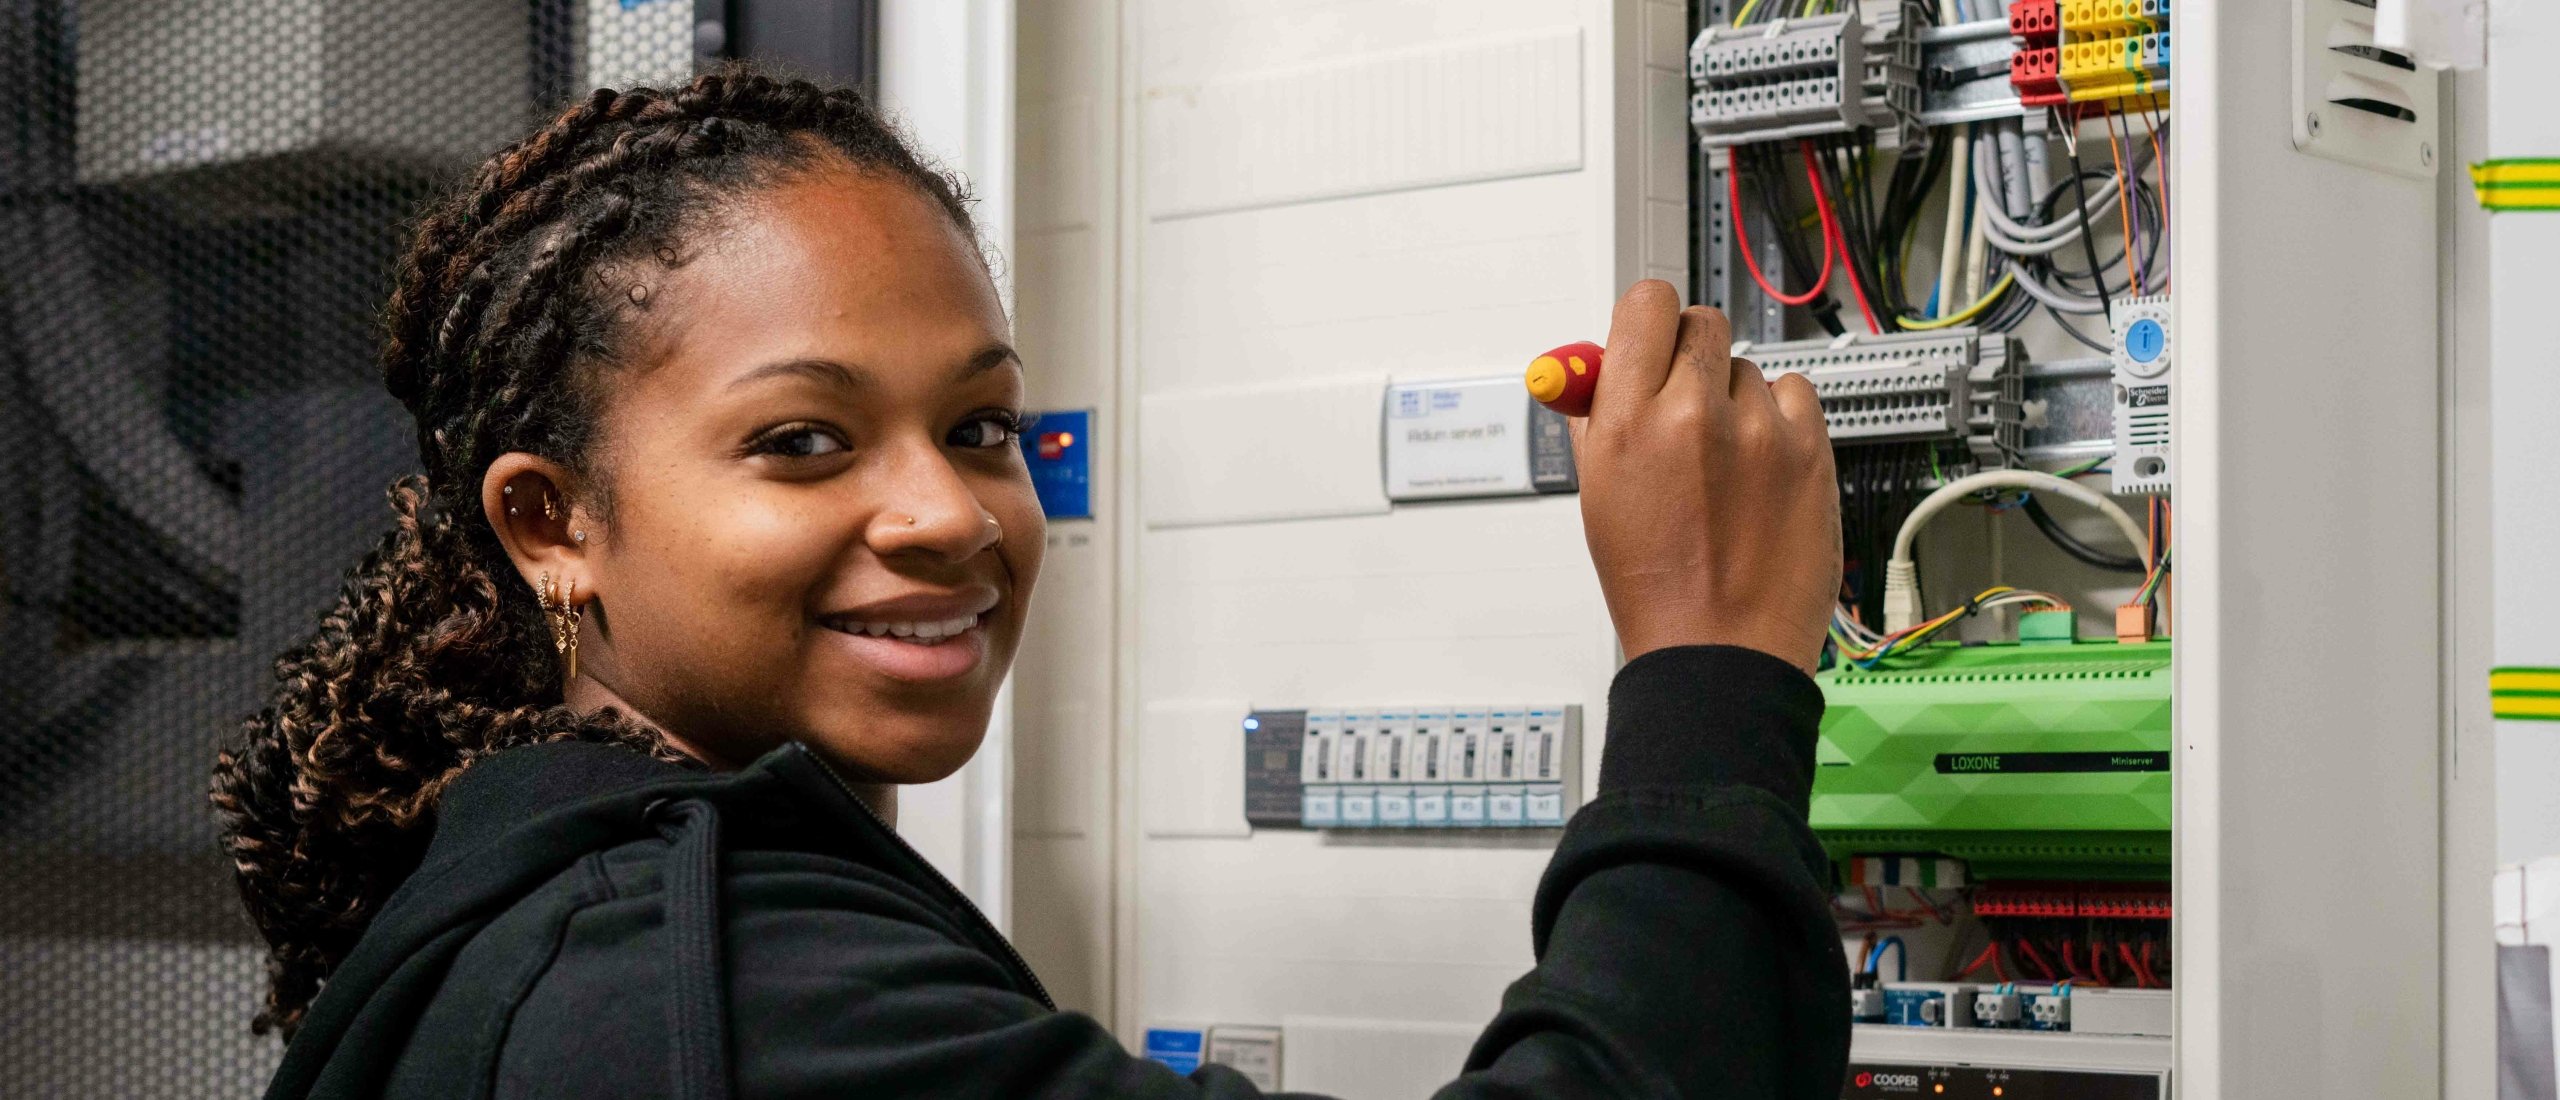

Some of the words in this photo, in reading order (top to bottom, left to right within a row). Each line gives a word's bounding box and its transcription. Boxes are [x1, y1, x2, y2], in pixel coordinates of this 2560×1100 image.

[2129, 386, 2168, 397] Schneider
[1951, 756, 2001, 771] LOXONE
[2111, 756, 2154, 767] Miniserver
[1873, 1073, 1919, 1087] COOPER
